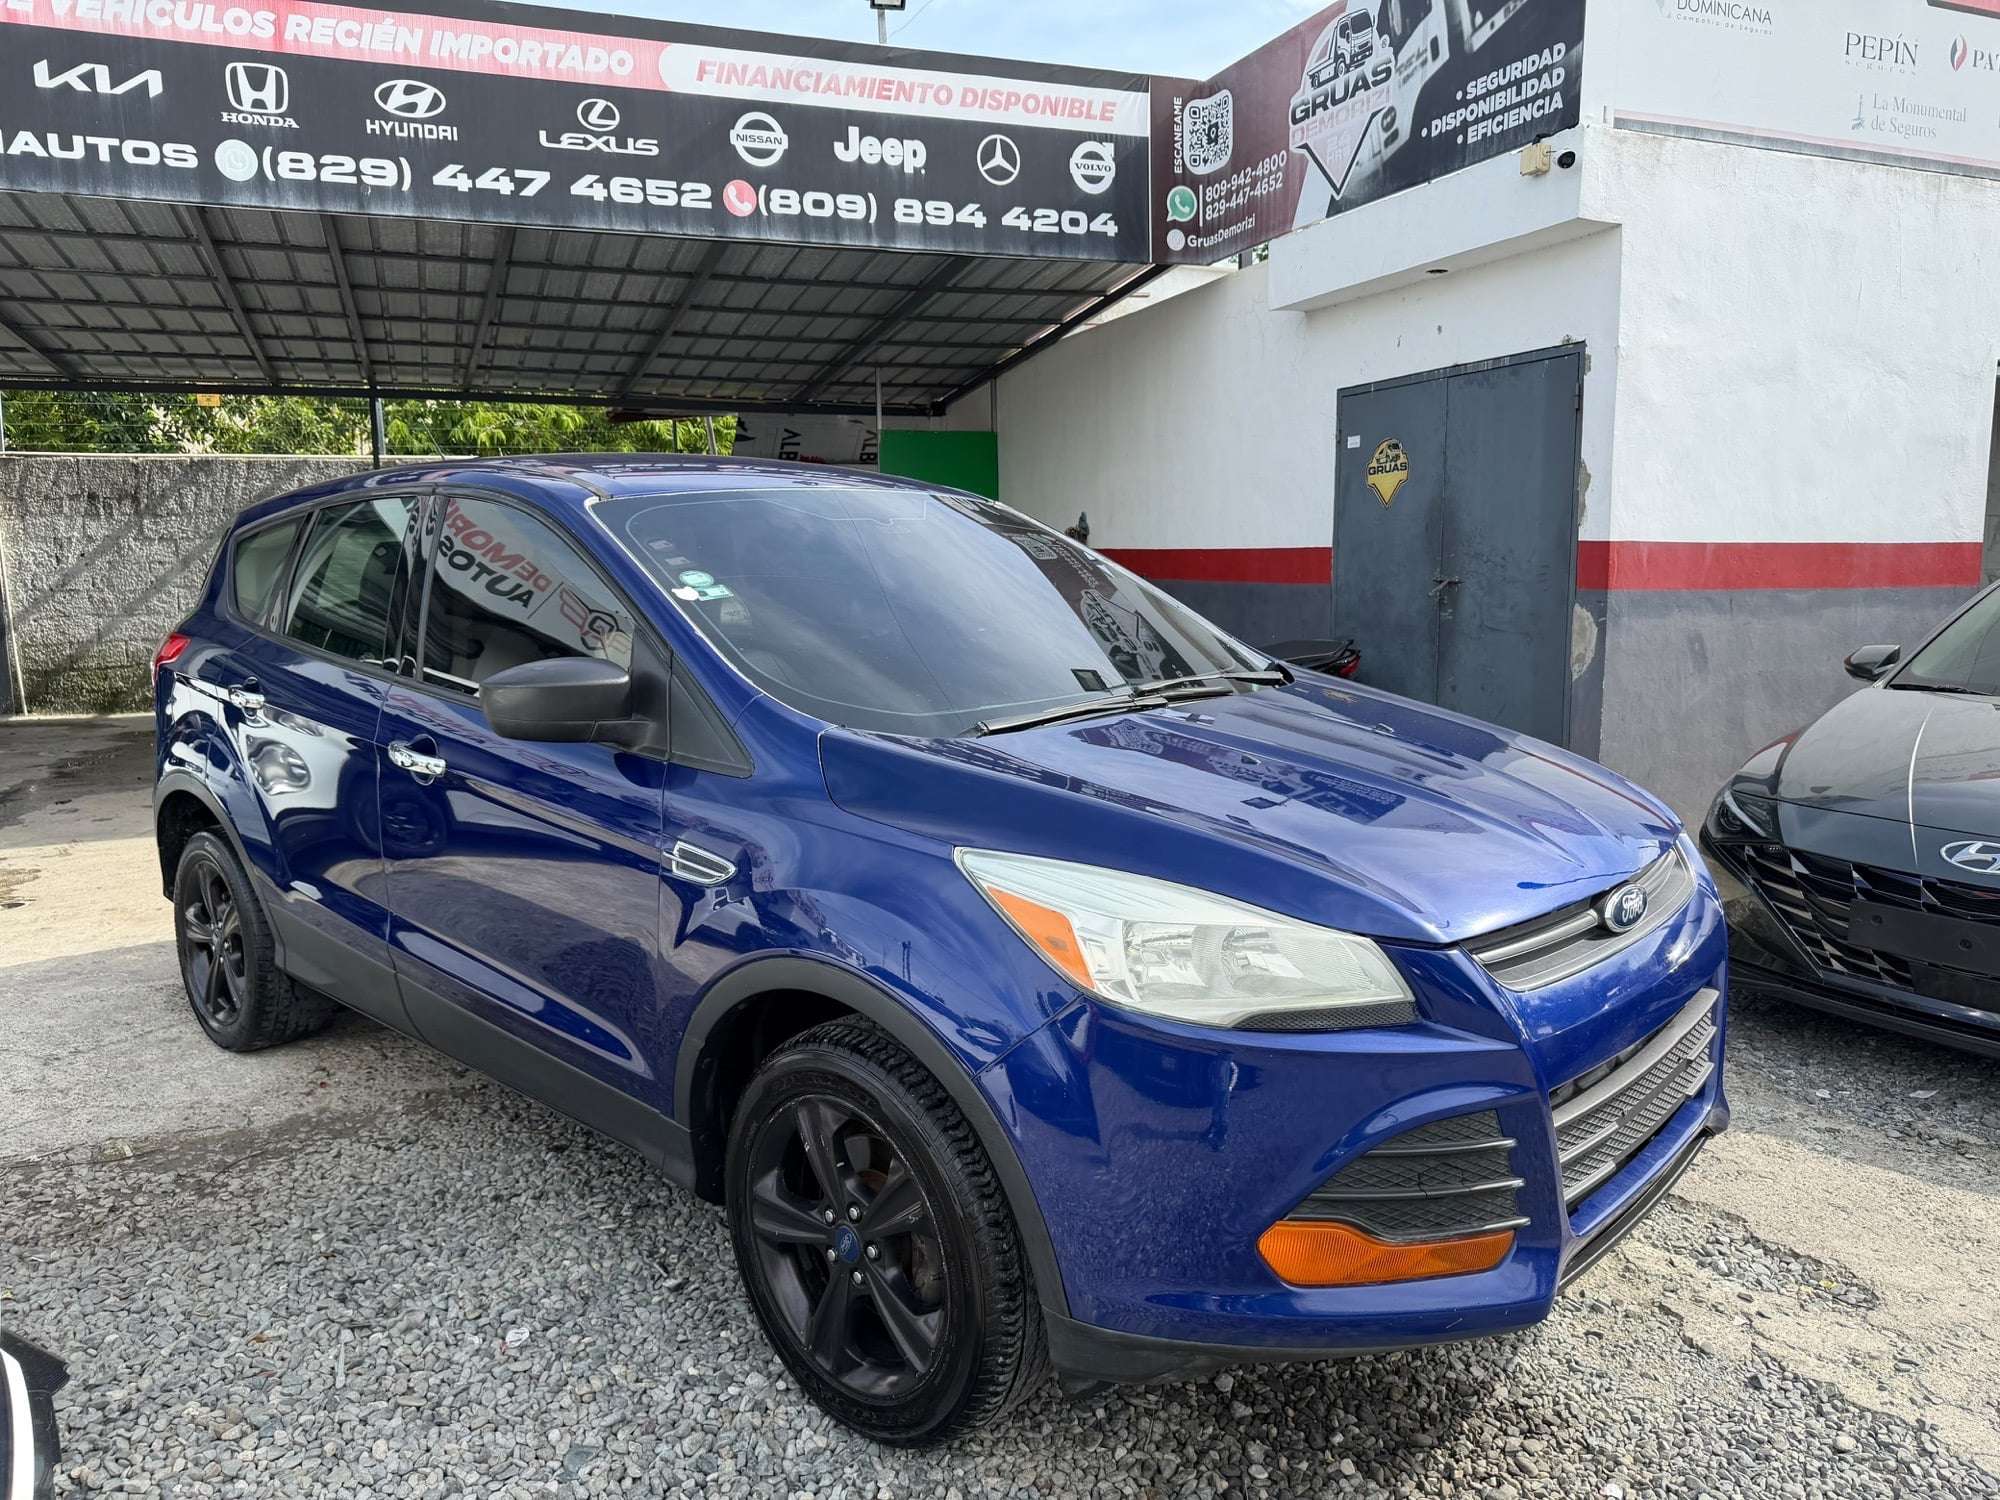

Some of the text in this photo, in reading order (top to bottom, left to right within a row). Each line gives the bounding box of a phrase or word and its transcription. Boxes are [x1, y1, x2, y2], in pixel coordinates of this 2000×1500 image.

[1677, 0, 1773, 25] DOMINICANA
[285, 14, 424, 56] RECIÉN
[429, 31, 635, 76] IMPORTADO
[1844, 32, 1919, 66] PEPÍN
[1466, 42, 1566, 99] SEGURIDAD
[695, 58, 1117, 122] FINANCIAMIENTO DISPONIBLE
[1291, 57, 1393, 126] GRUAS
[1431, 67, 1565, 137] DISPONIBILIDAD
[1873, 92, 1968, 122] La Monumental
[222, 111, 300, 129] HONDA
[366, 119, 458, 141] HYUNDAI
[1467, 91, 1563, 144] EFICIENCIA
[1871, 115, 1938, 140] de Seguros
[539, 130, 659, 156] LEXUS
[736, 132, 783, 146] NISSAN
[1173, 96, 1183, 174] ESCANEAME
[1074, 160, 1113, 175] VOLVO
[1205, 150, 1288, 201] 809-942-4800
[262, 151, 412, 192] (829)
[432, 164, 551, 198] 447
[570, 174, 713, 210] 4652
[758, 183, 878, 224] (809)
[893, 198, 987, 228] 894
[1001, 205, 1118, 238] 4204
[1205, 171, 1284, 221] 829-447-4652
[1187, 213, 1256, 247] GruasDemorizi
[1368, 462, 1408, 476] GRUAS
